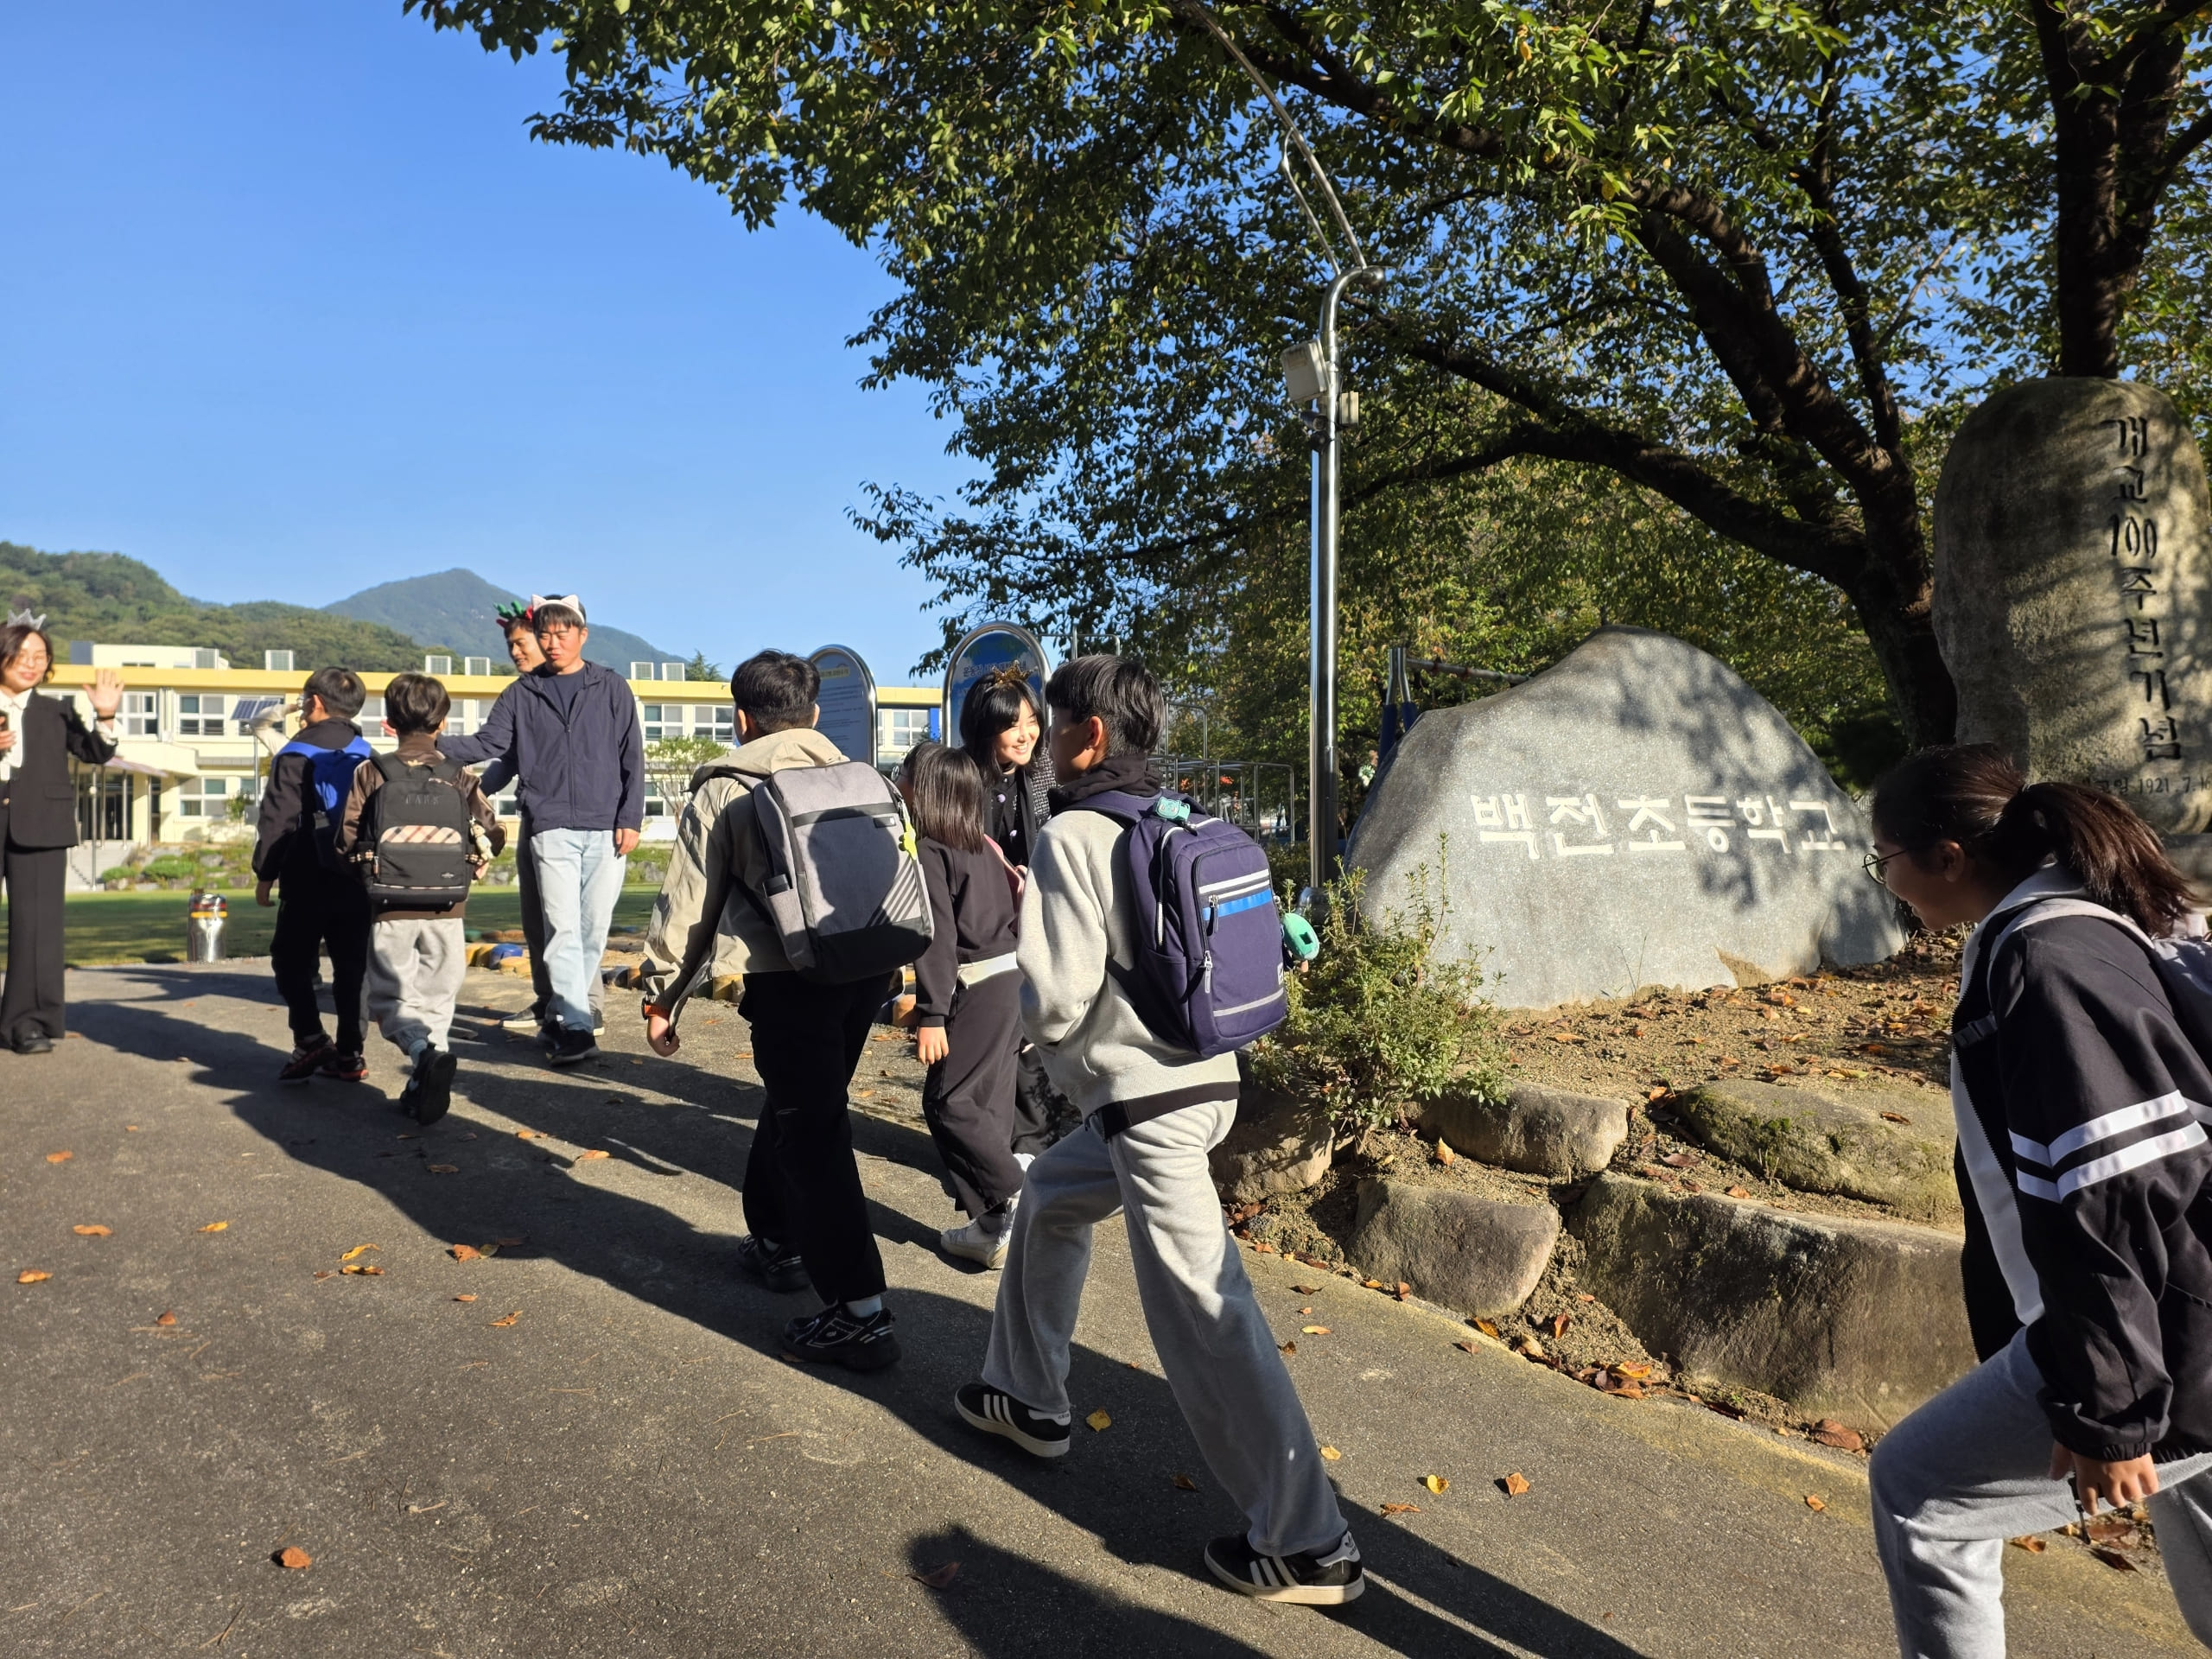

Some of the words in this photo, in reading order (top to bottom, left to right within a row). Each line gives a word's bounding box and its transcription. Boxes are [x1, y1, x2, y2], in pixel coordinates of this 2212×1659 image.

[2097, 416, 2182, 762] 개교100주년기념
[2082, 777, 2129, 796] 교일
[1470, 793, 1847, 860] 백전초등학교
